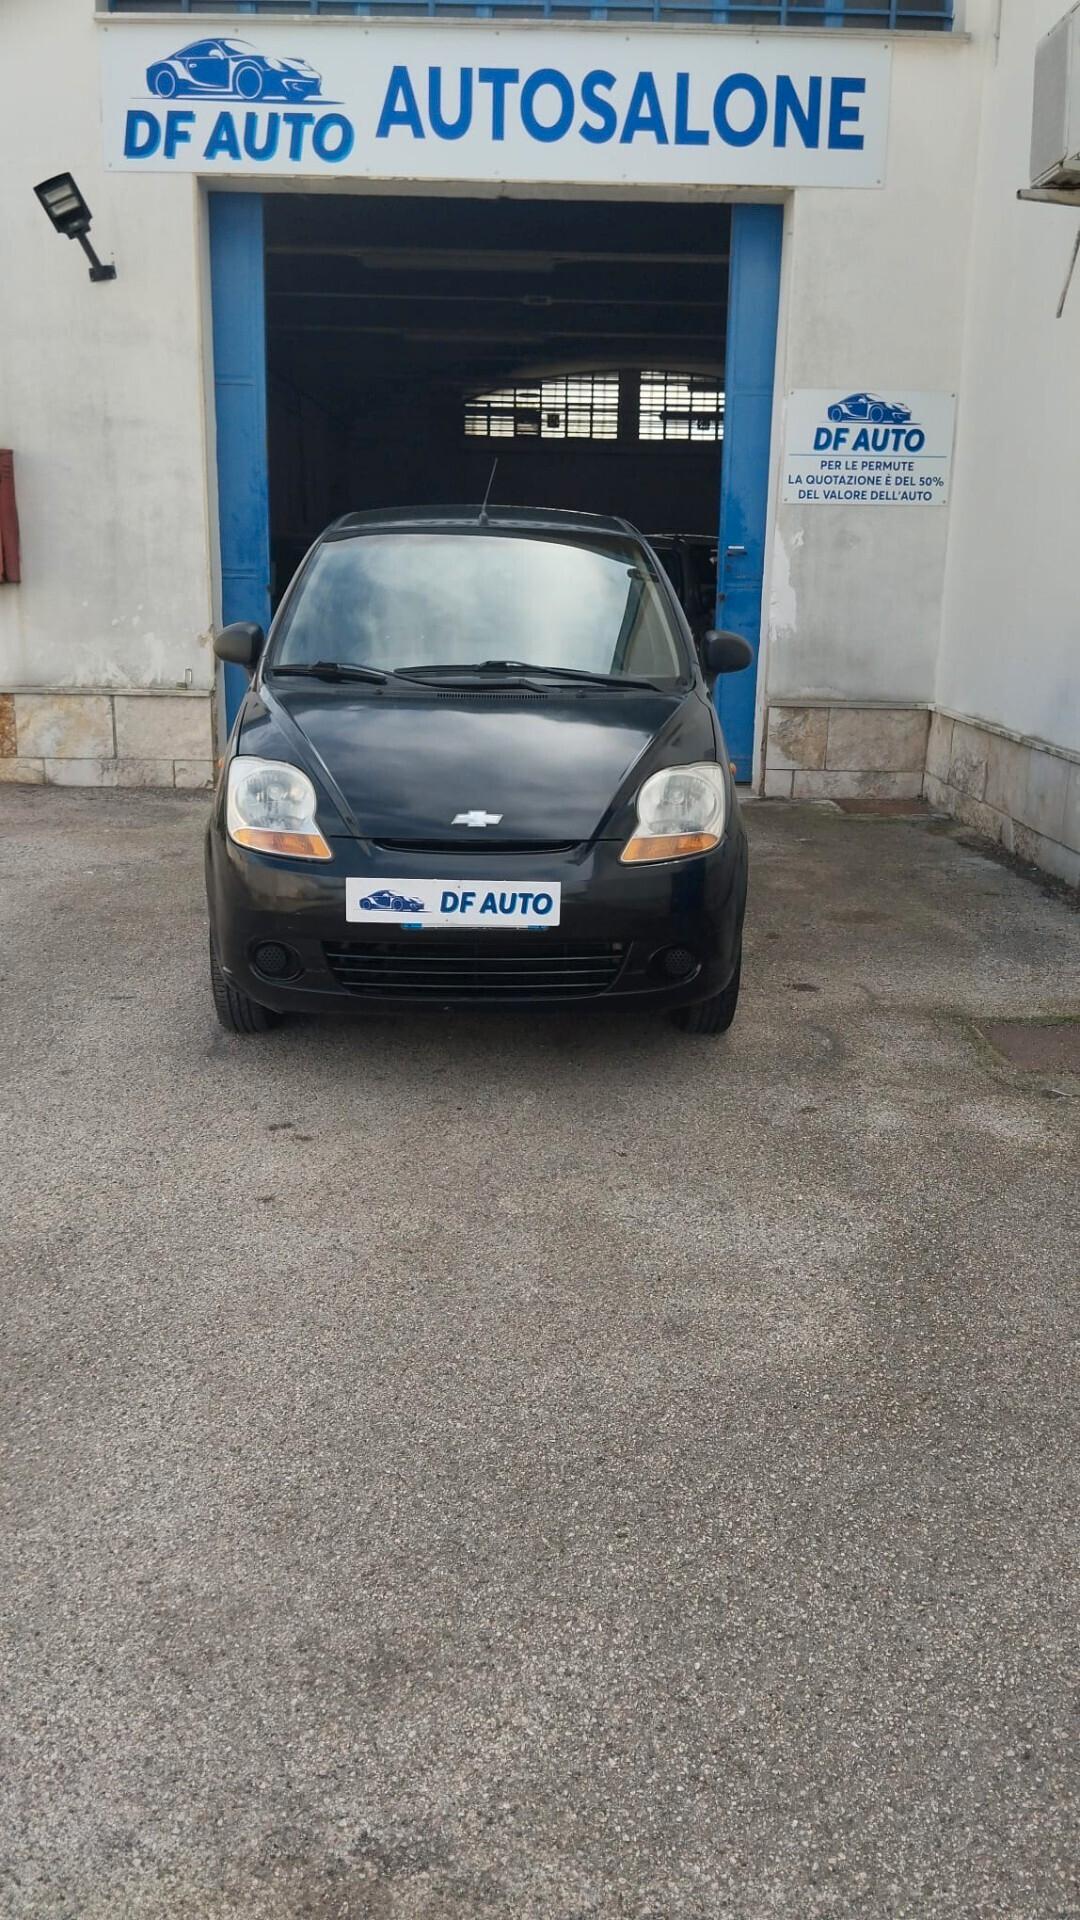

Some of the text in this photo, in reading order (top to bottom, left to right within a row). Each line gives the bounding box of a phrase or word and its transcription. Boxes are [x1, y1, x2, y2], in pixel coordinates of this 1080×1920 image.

[374, 64, 867, 151] AUTOSALONE
[123, 109, 355, 163] DF AUTO
[813, 427, 925, 452] DF AUTO
[820, 460, 915, 471] PER LE PERMUTE
[788, 474, 803, 485] LA
[806, 475, 881, 486] QUOTAZIONE
[895, 476, 916, 486] DEL
[919, 476, 945, 487] 50%
[798, 489, 933, 501] DEL VALORE DELL'AUTO
[440, 891, 554, 915] DF AUTO
